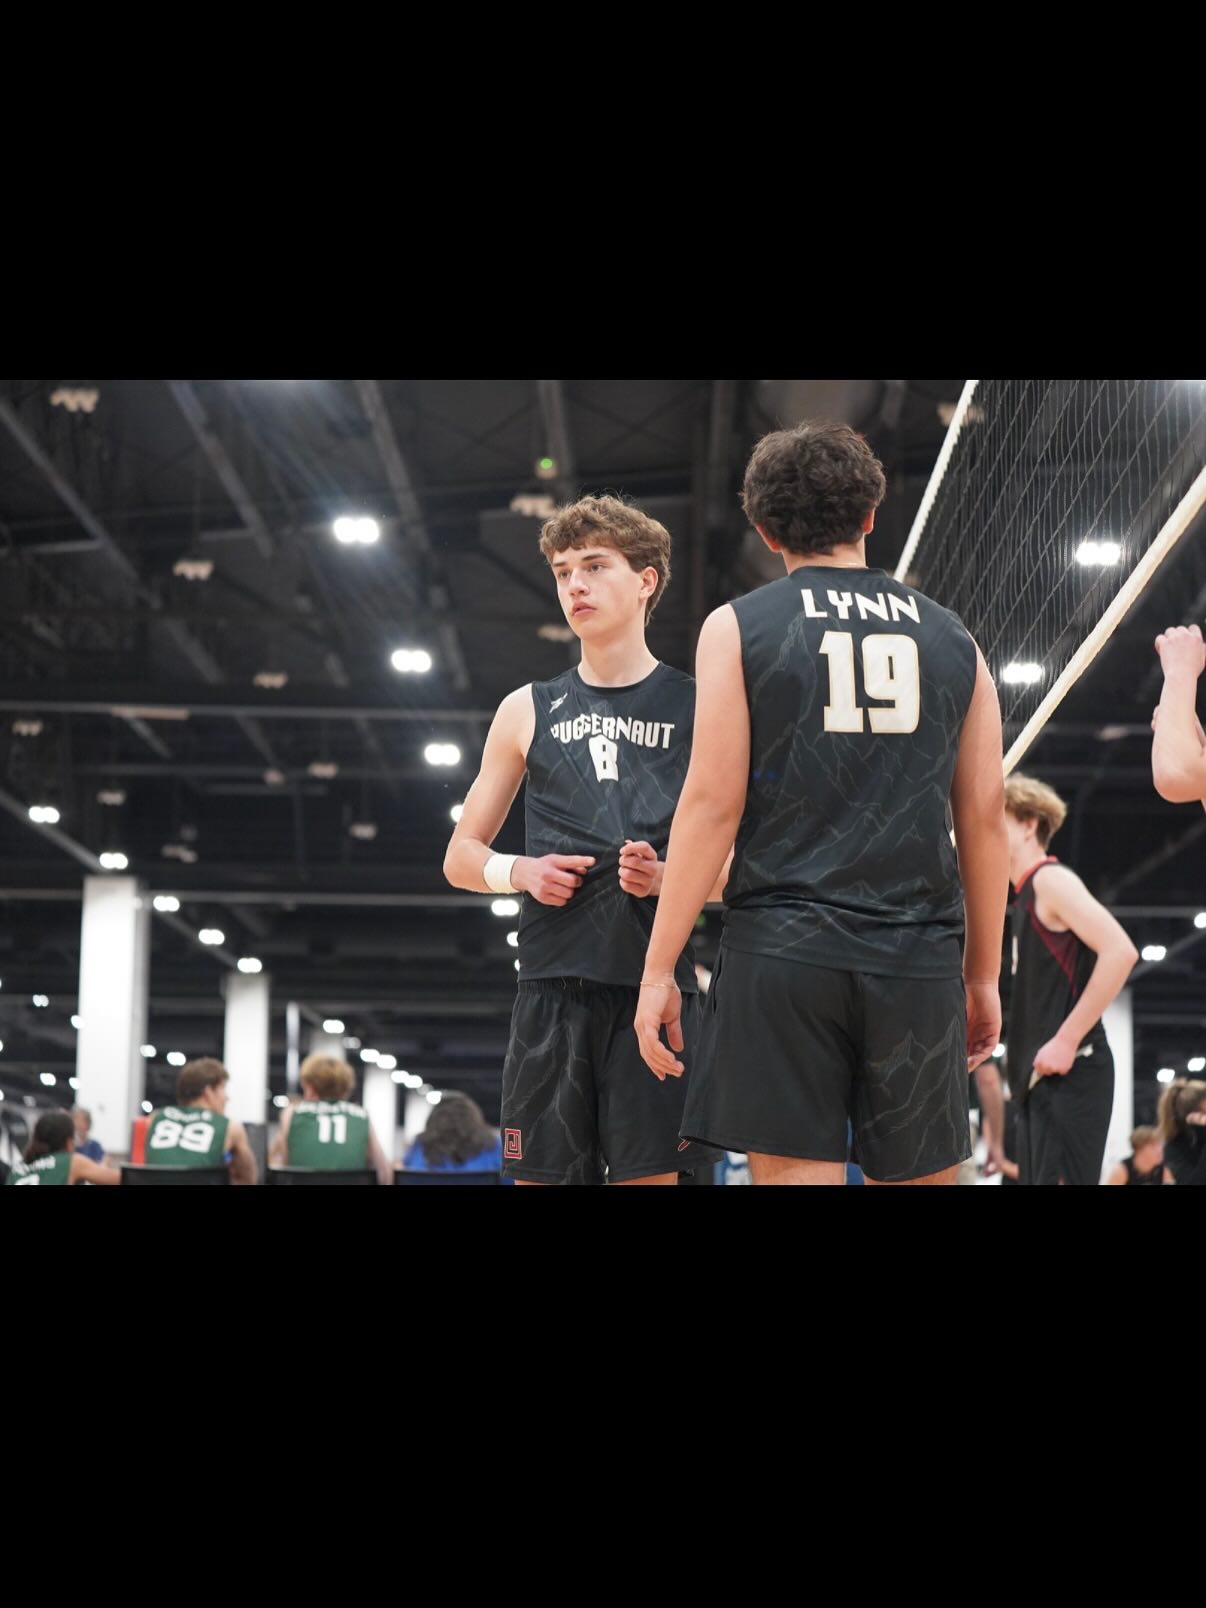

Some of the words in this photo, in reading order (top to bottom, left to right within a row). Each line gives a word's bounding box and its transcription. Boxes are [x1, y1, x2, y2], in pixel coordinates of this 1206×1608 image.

[801, 588, 921, 624] LYNN
[818, 630, 921, 734] 19
[550, 712, 675, 749] JUGGERNAUT
[150, 1119, 215, 1153] 89
[317, 1114, 347, 1144] 11
